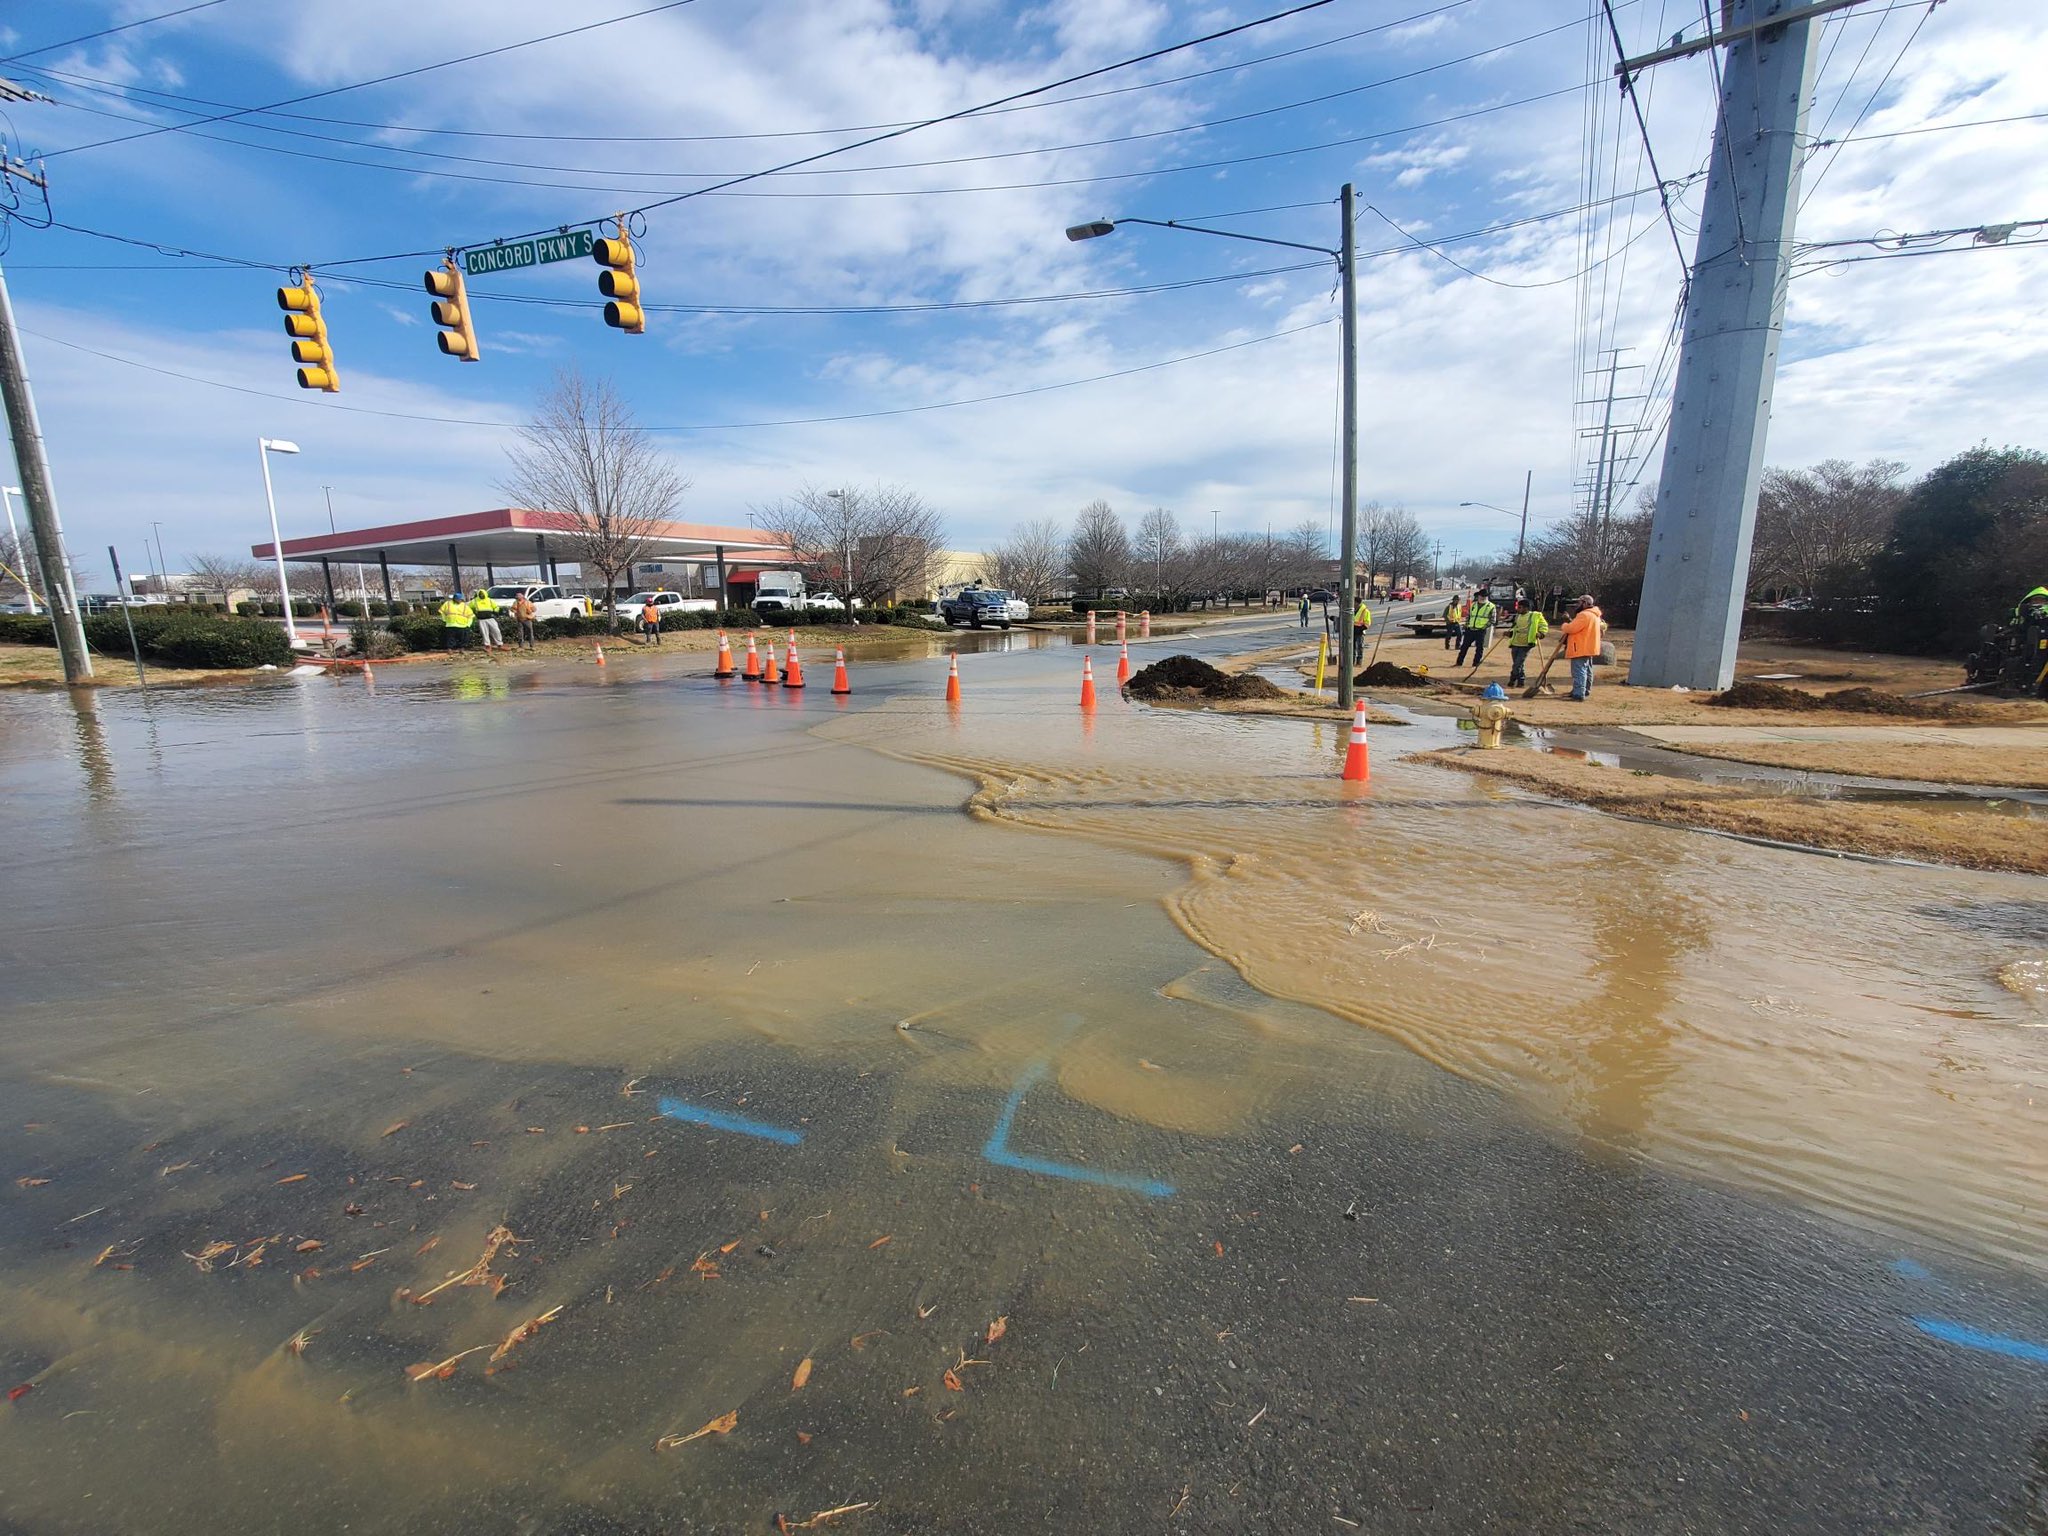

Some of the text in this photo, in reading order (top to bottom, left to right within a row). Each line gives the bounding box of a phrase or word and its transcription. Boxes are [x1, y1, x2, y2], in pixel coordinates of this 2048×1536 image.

[469, 233, 593, 273] CONCORD PKWY S
